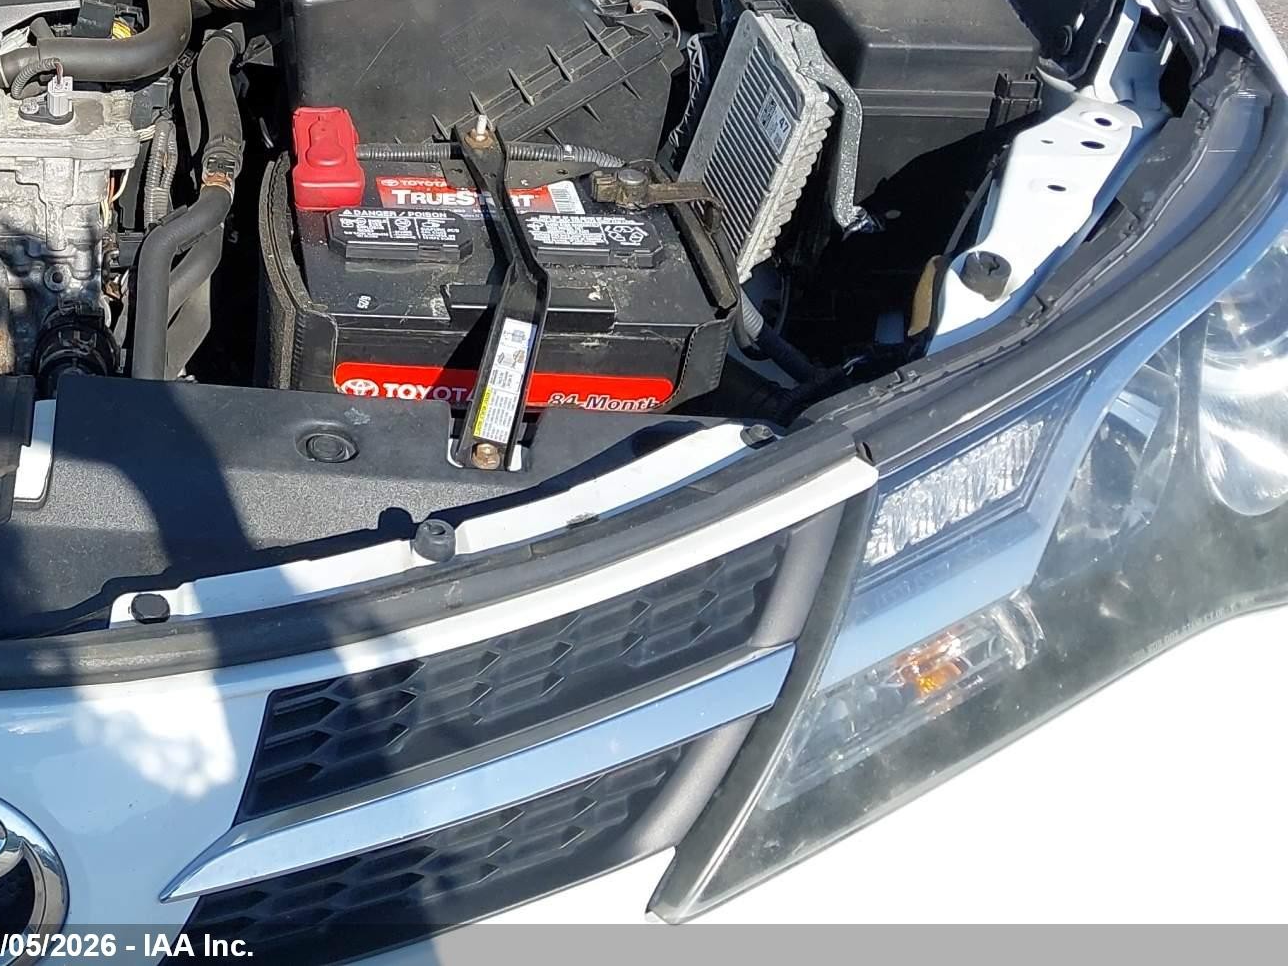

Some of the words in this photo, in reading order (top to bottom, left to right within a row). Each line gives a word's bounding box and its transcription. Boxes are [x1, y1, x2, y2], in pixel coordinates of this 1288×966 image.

[400, 179, 448, 188] TOYOTA
[353, 209, 397, 218] DANGER
[407, 211, 447, 219] POISON
